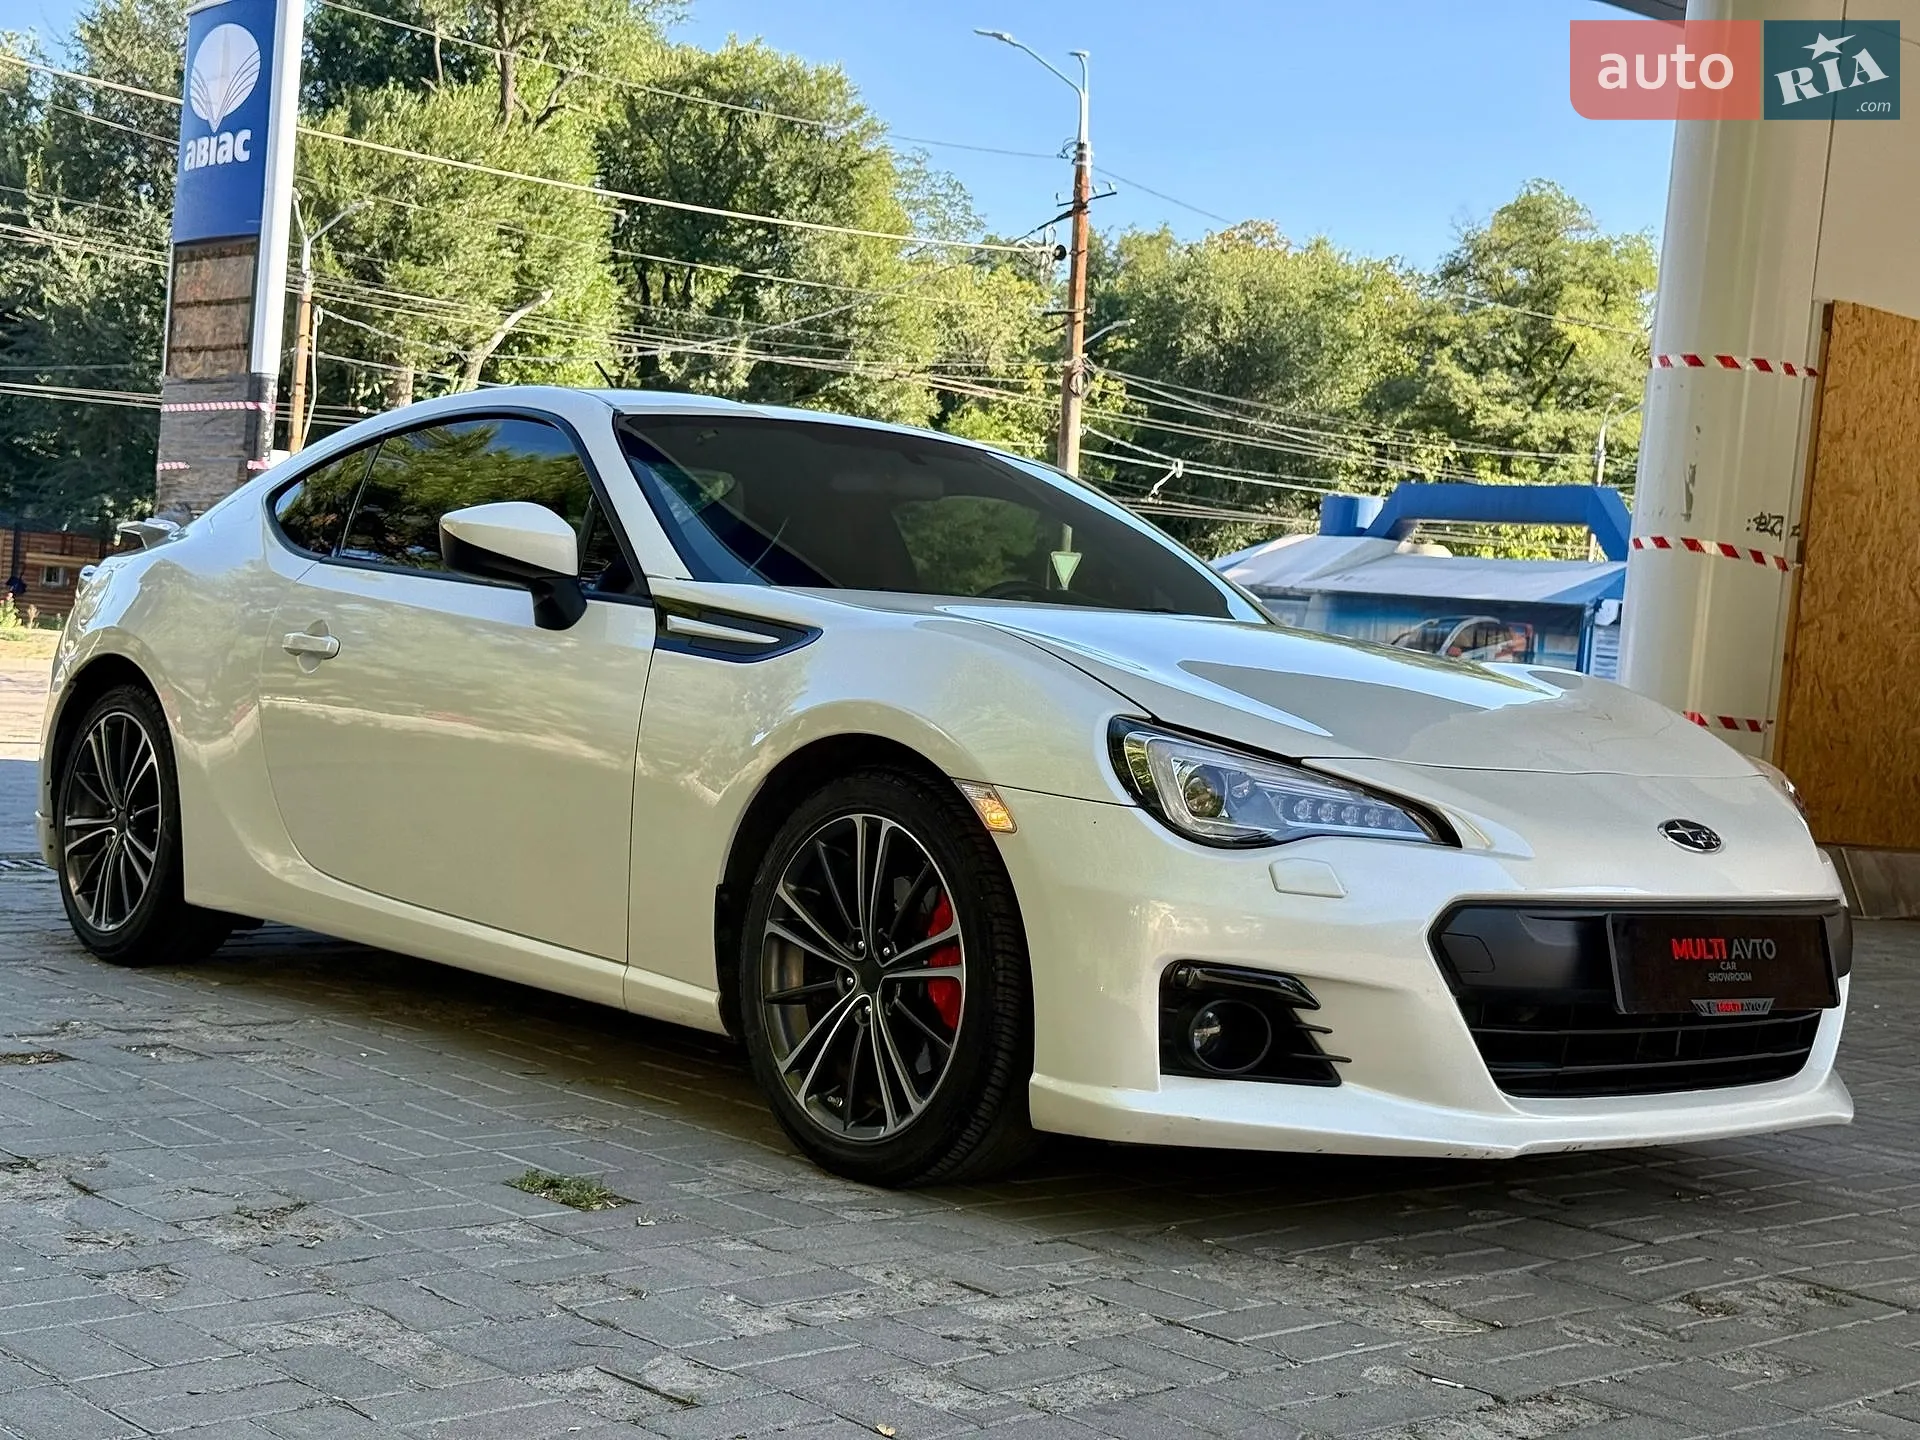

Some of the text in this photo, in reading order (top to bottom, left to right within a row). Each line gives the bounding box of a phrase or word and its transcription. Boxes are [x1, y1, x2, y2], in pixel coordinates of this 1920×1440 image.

[1671, 938, 1776, 960] MULTI AVTO
[1720, 961, 1737, 971] CAR
[1708, 972, 1752, 982] SHOWROOM
